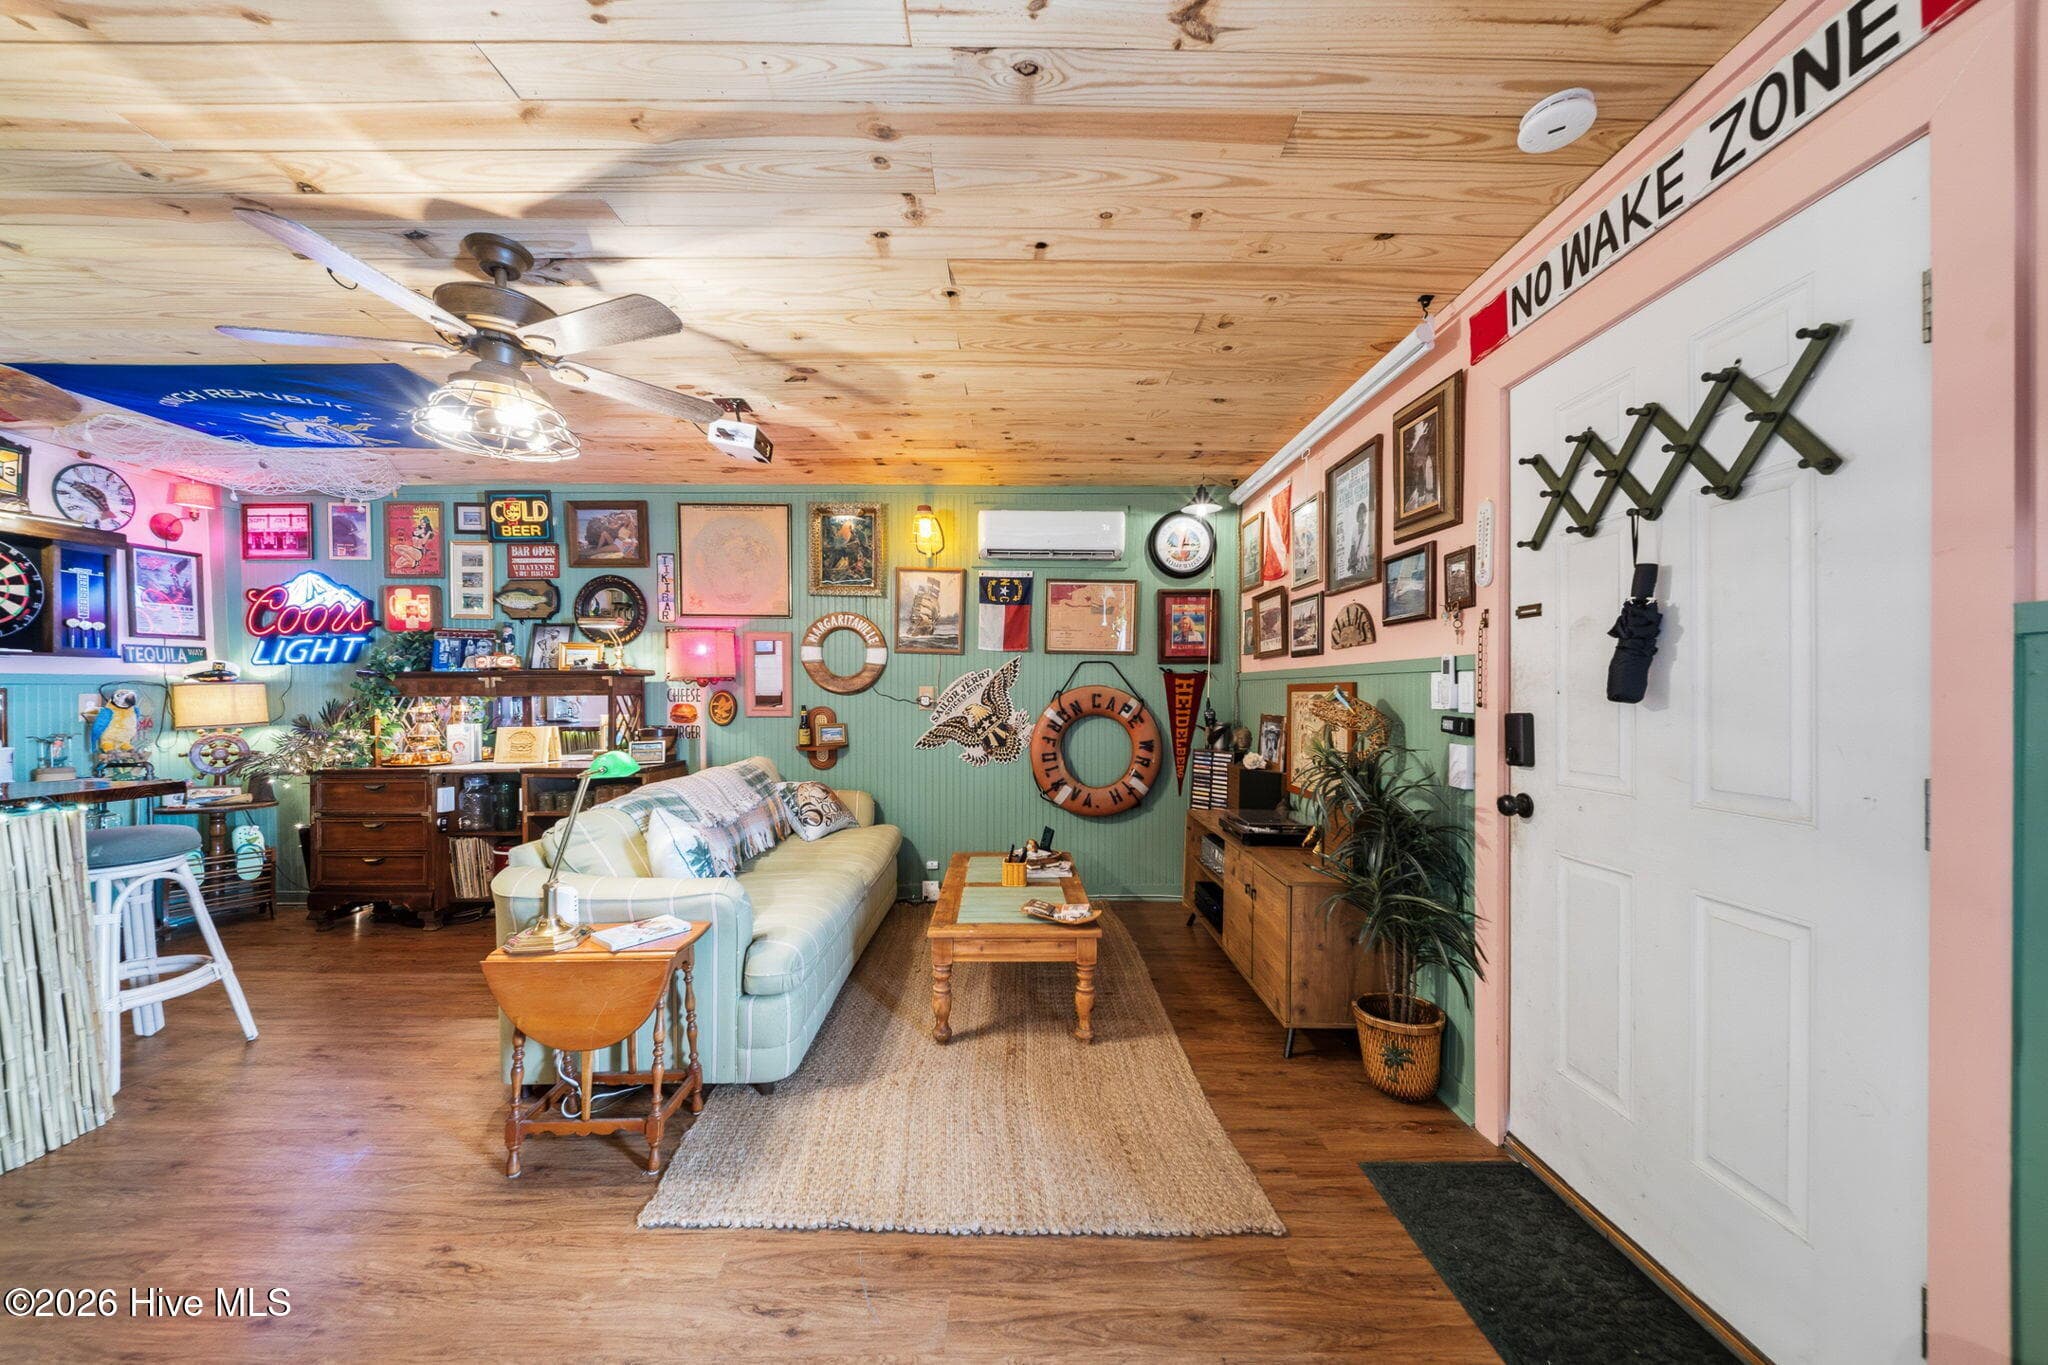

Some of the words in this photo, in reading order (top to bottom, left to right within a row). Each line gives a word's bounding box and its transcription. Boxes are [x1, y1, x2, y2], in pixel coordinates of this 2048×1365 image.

[1511, 262, 1552, 327] NO
[1562, 148, 1685, 290] WAKE
[1709, 0, 1901, 181] ZONE
[203, 387, 353, 412] REPUBLIC
[490, 499, 549, 523] COLD
[501, 524, 542, 537] BEER
[511, 545, 530, 556] BAR
[532, 545, 556, 556] OPEN
[248, 586, 373, 635] Coors
[807, 614, 880, 644] MARGARITAVILLE
[126, 646, 188, 662] TEQUILA
[187, 648, 204, 656] WAY
[252, 636, 366, 665] LIGHT
[667, 689, 701, 702] CHEESE
[931, 690, 960, 722] SAILOR
[960, 669, 990, 693] JERRY
[1091, 693, 1145, 729] CAPE
[1175, 678, 1195, 778] HEIDELBERG
